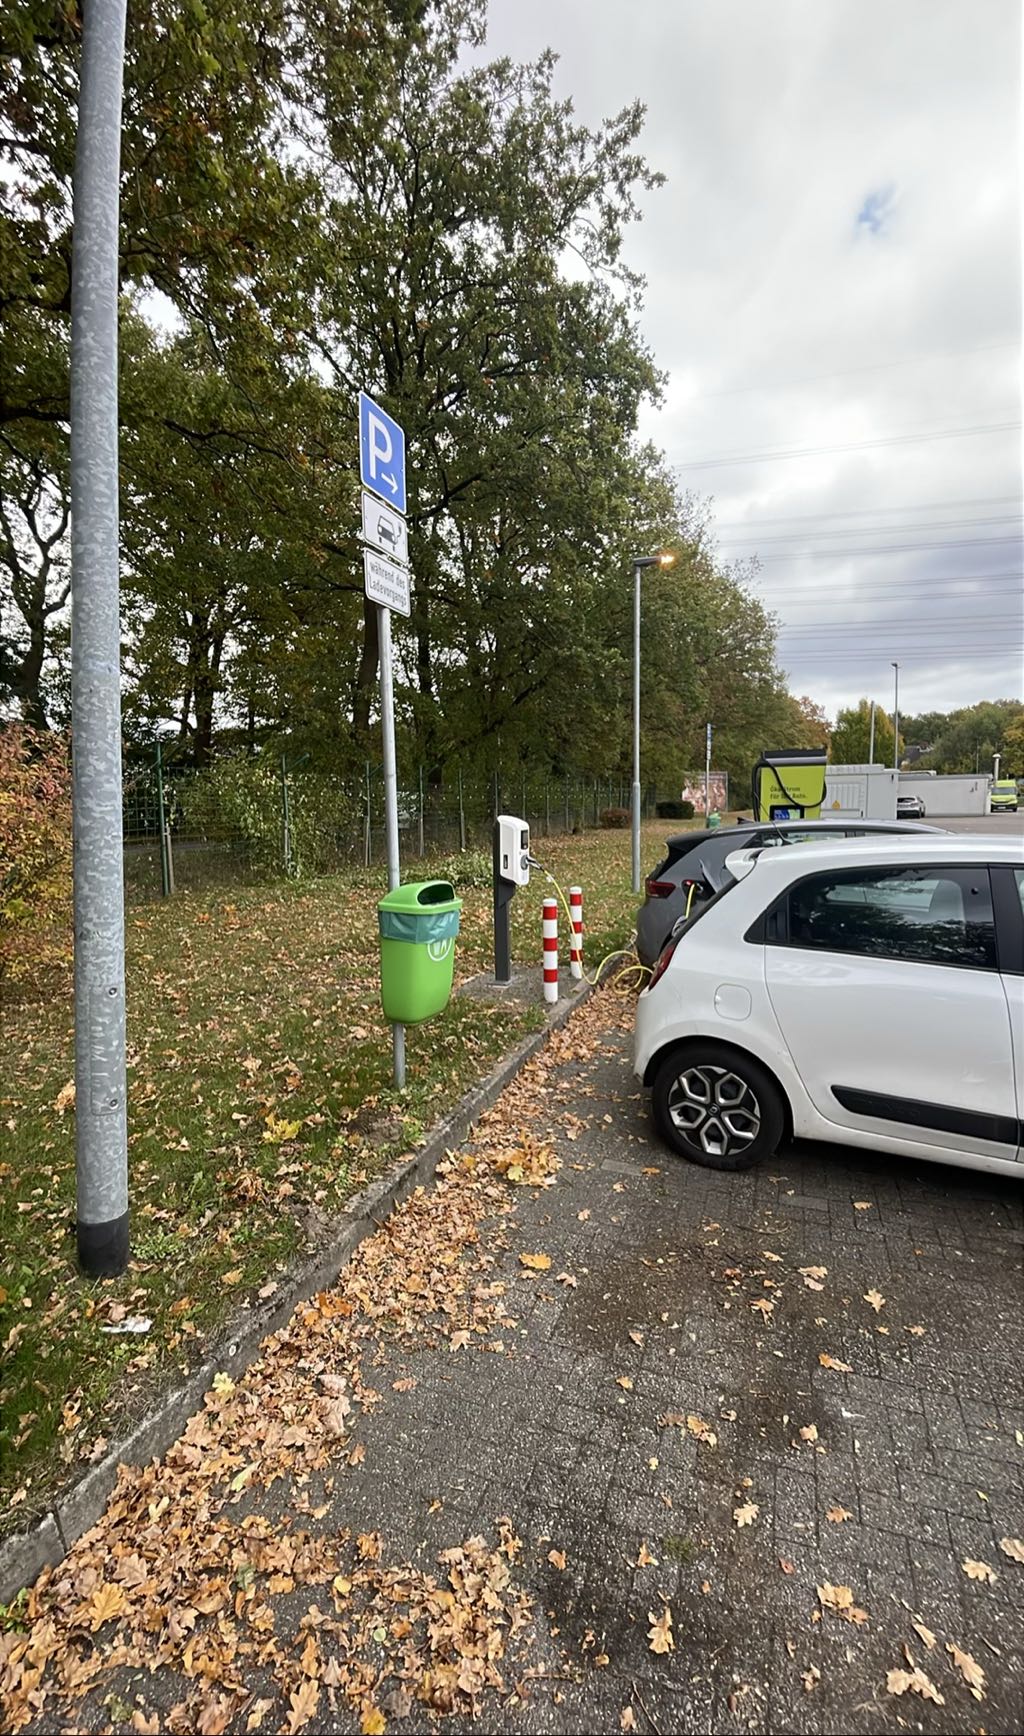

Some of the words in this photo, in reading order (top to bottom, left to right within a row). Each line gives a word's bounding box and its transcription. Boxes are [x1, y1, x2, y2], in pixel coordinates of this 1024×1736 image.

[369, 411, 392, 479] P
[370, 561, 394, 583] während
[396, 574, 405, 590] des
